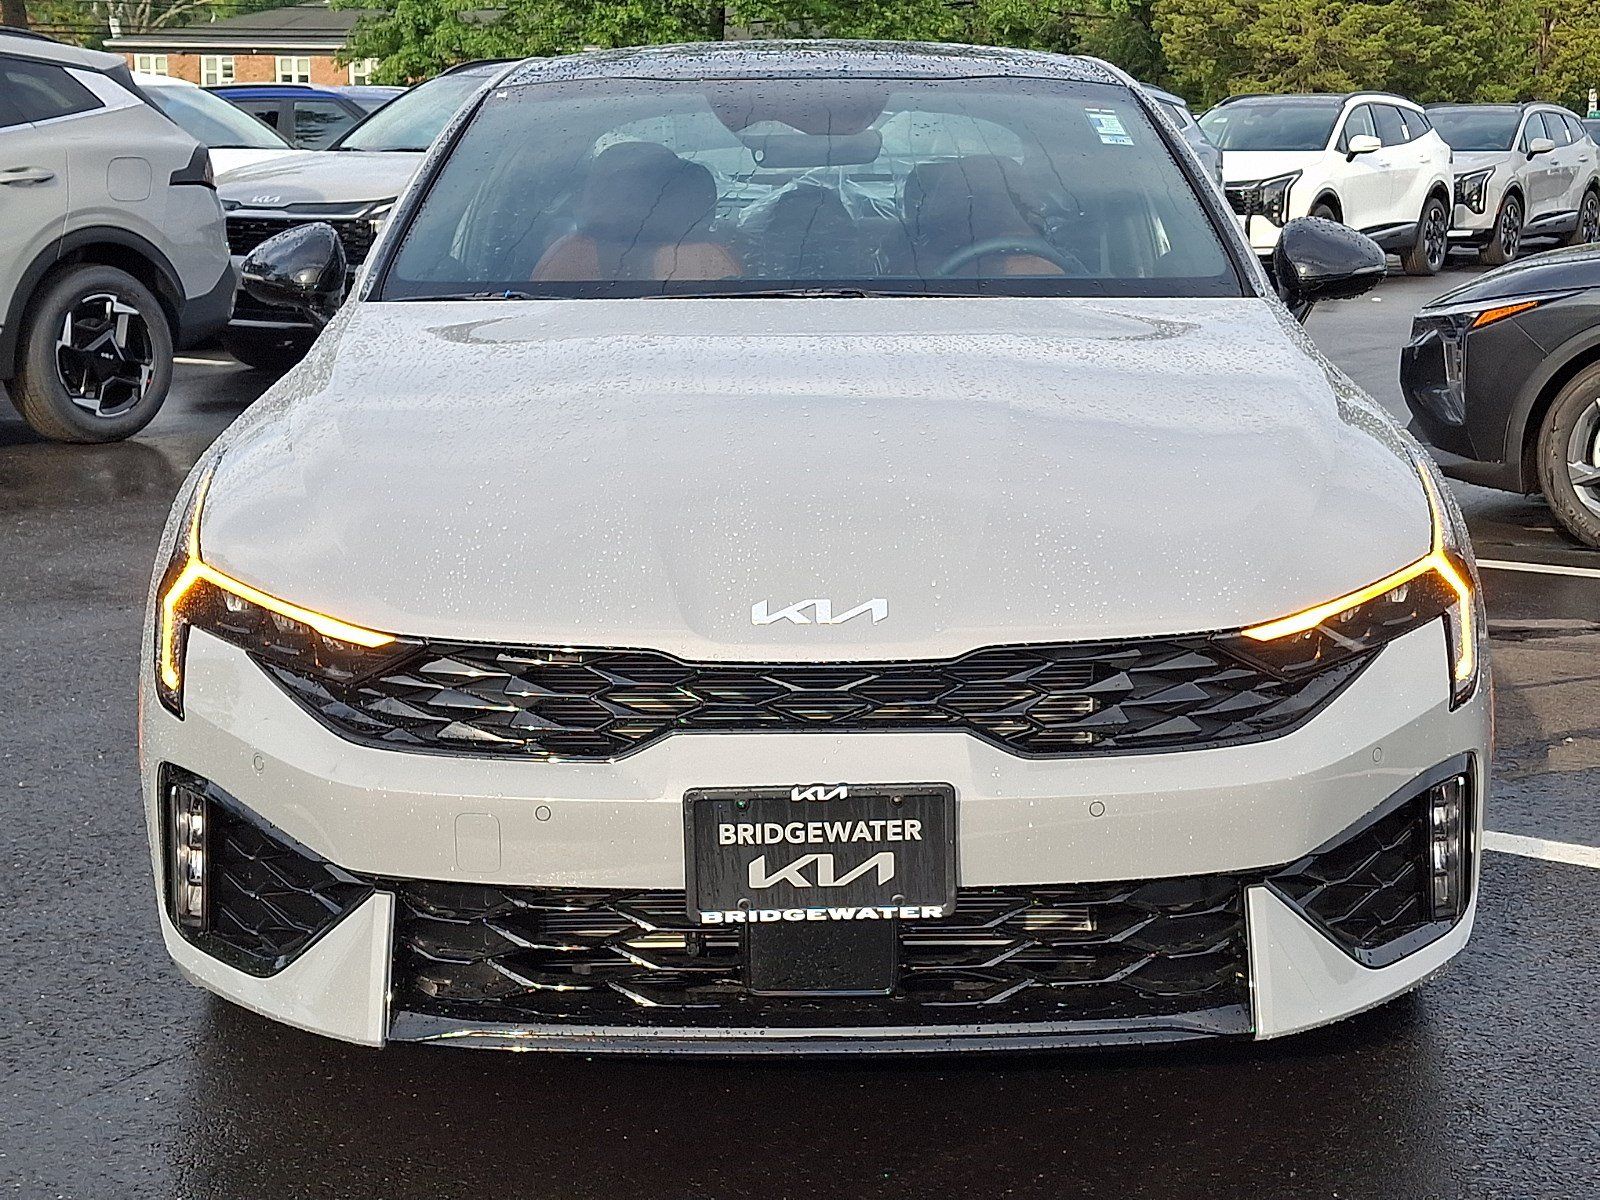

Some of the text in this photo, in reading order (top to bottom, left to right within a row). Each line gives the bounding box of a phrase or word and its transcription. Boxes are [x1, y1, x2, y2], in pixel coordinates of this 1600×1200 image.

[751, 598, 889, 625] KIA
[790, 785, 848, 802] KIA
[718, 819, 923, 846] BRIDGEWATER
[748, 851, 895, 889] KIA
[700, 905, 943, 925] BRIDGEWATER
